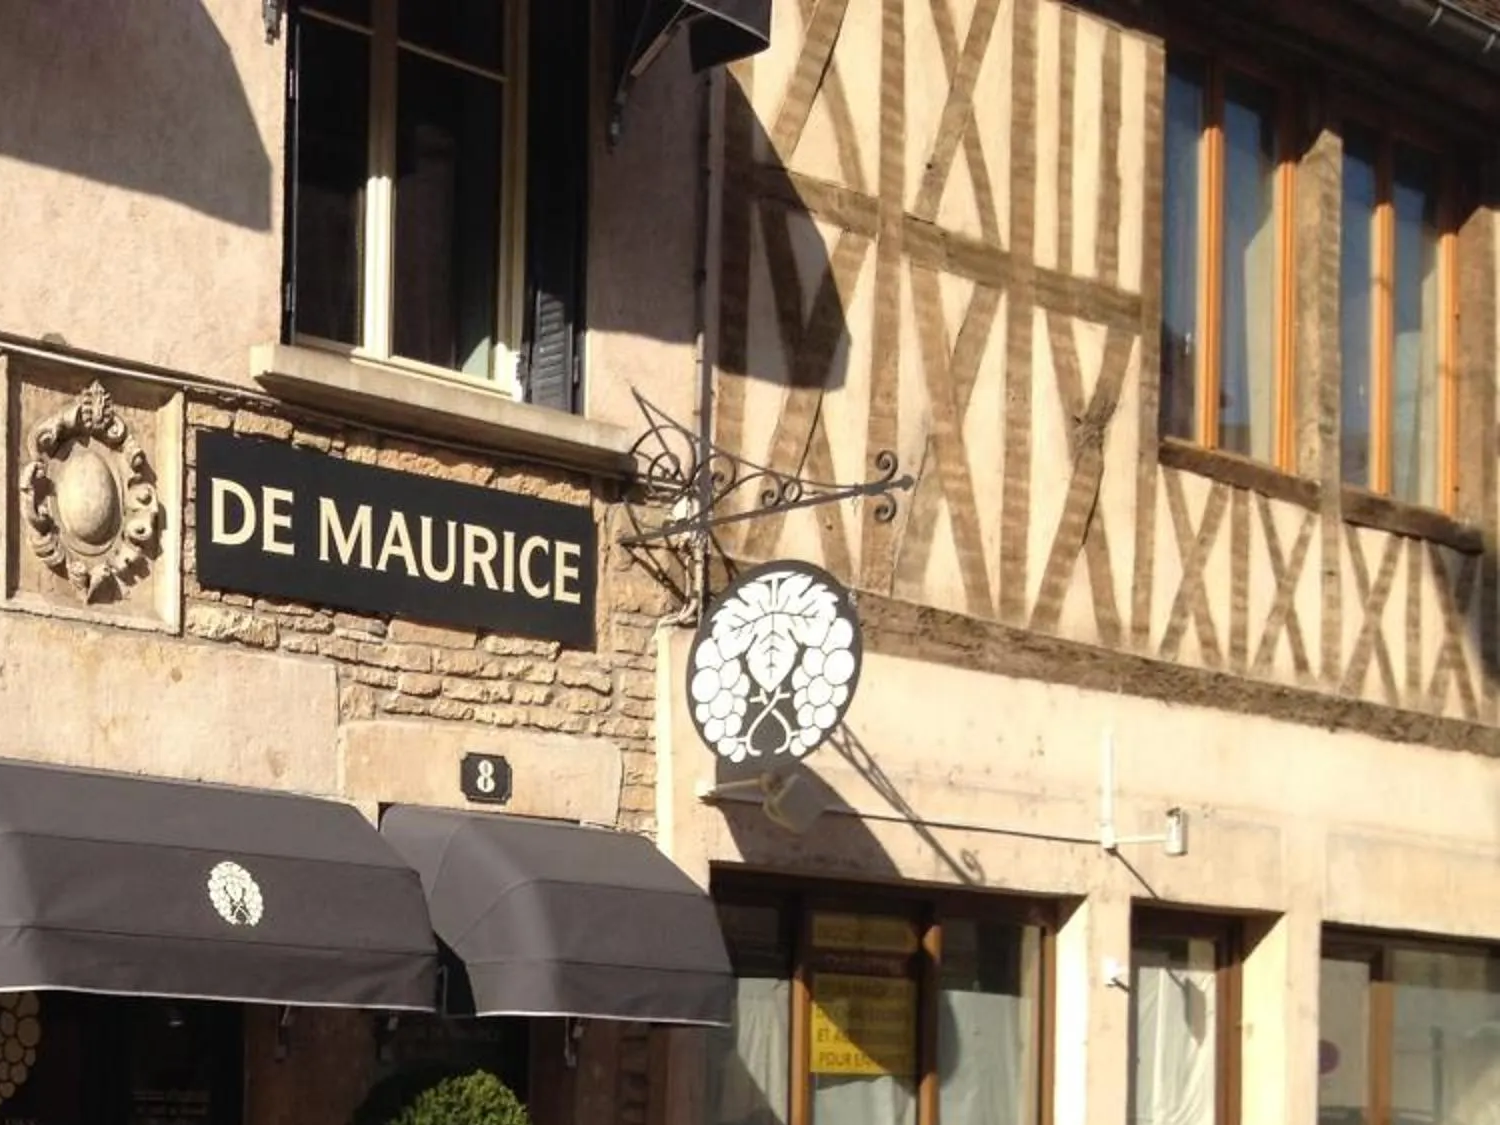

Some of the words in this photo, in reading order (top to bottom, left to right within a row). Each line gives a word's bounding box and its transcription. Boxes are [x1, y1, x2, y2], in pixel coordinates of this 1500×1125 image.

[210, 478, 295, 559] DE
[317, 496, 582, 606] MAURICE
[476, 759, 495, 793] 8
